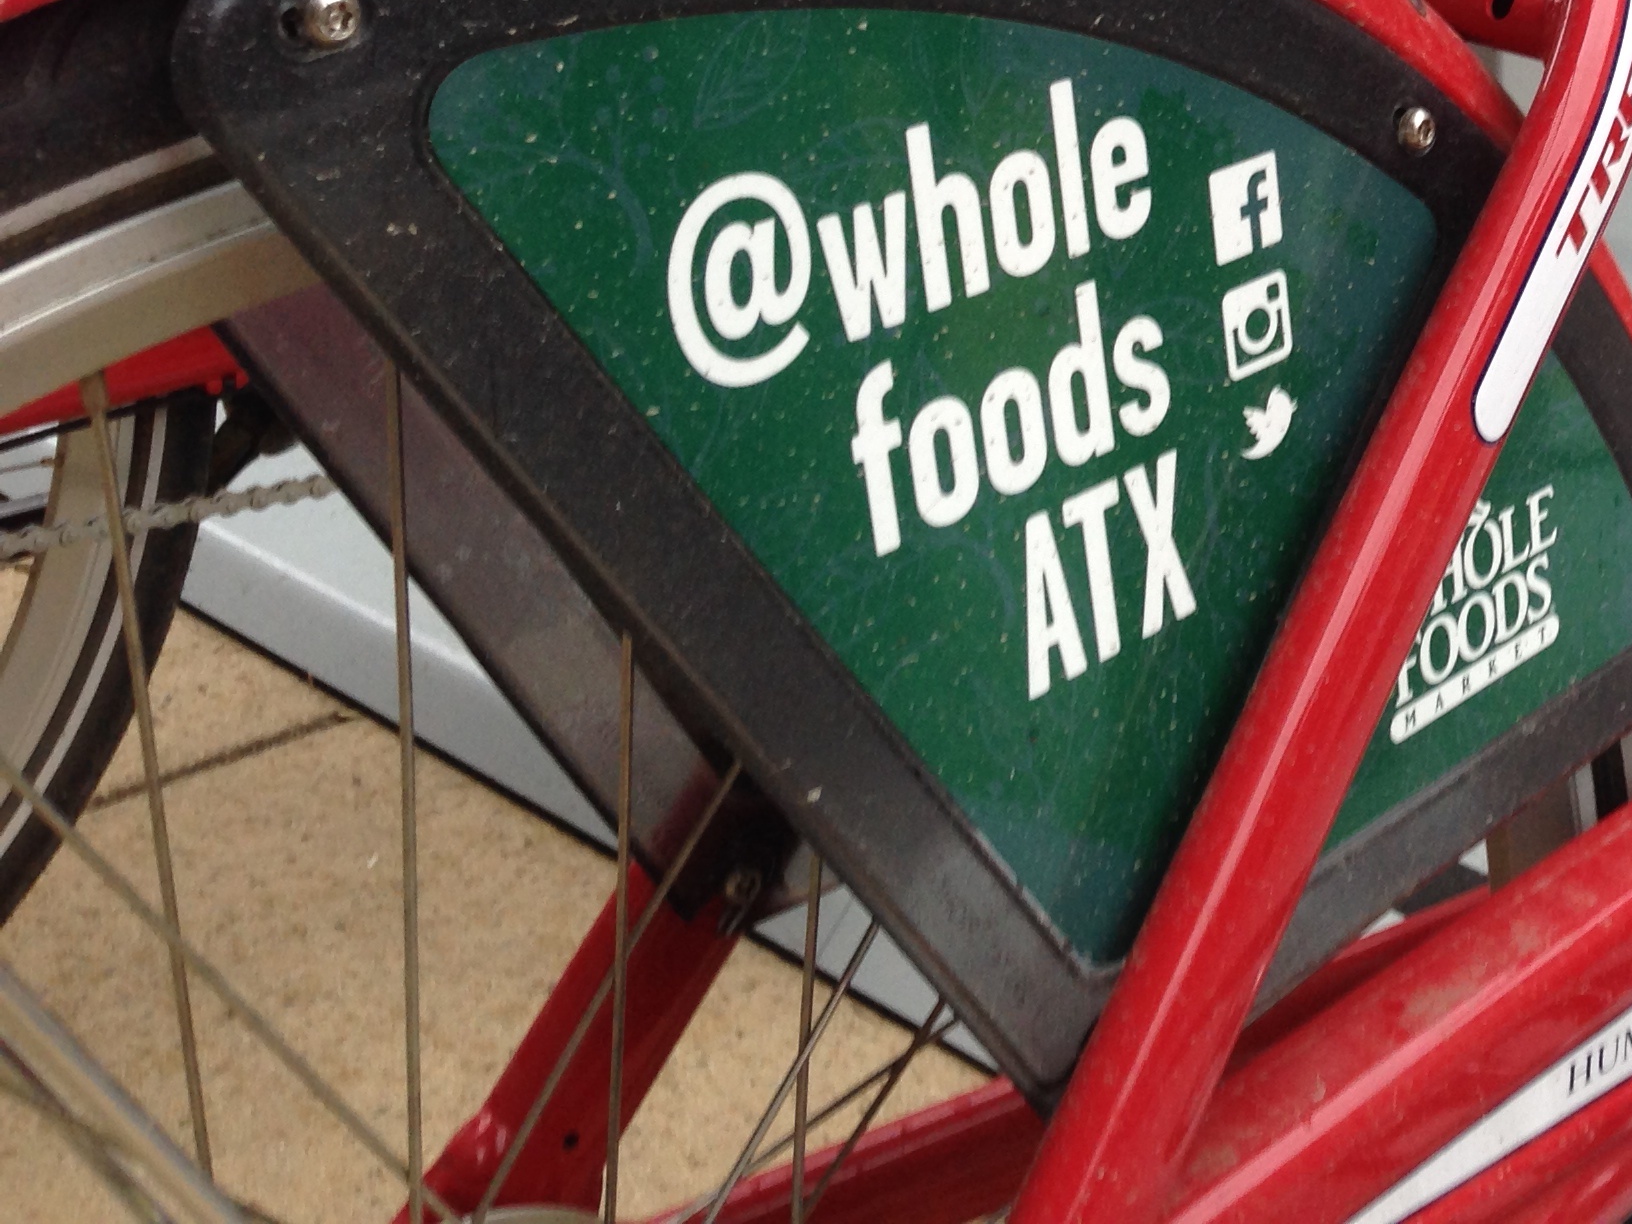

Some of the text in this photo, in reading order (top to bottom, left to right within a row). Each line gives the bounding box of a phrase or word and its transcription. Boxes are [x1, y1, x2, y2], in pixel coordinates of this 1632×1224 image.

[667, 77, 1152, 388] @whole
[851, 278, 1171, 557] foods
[1025, 448, 1197, 701] ATX
[1430, 483, 1558, 616] HOLE
[1401, 625, 1547, 734] MARKET
